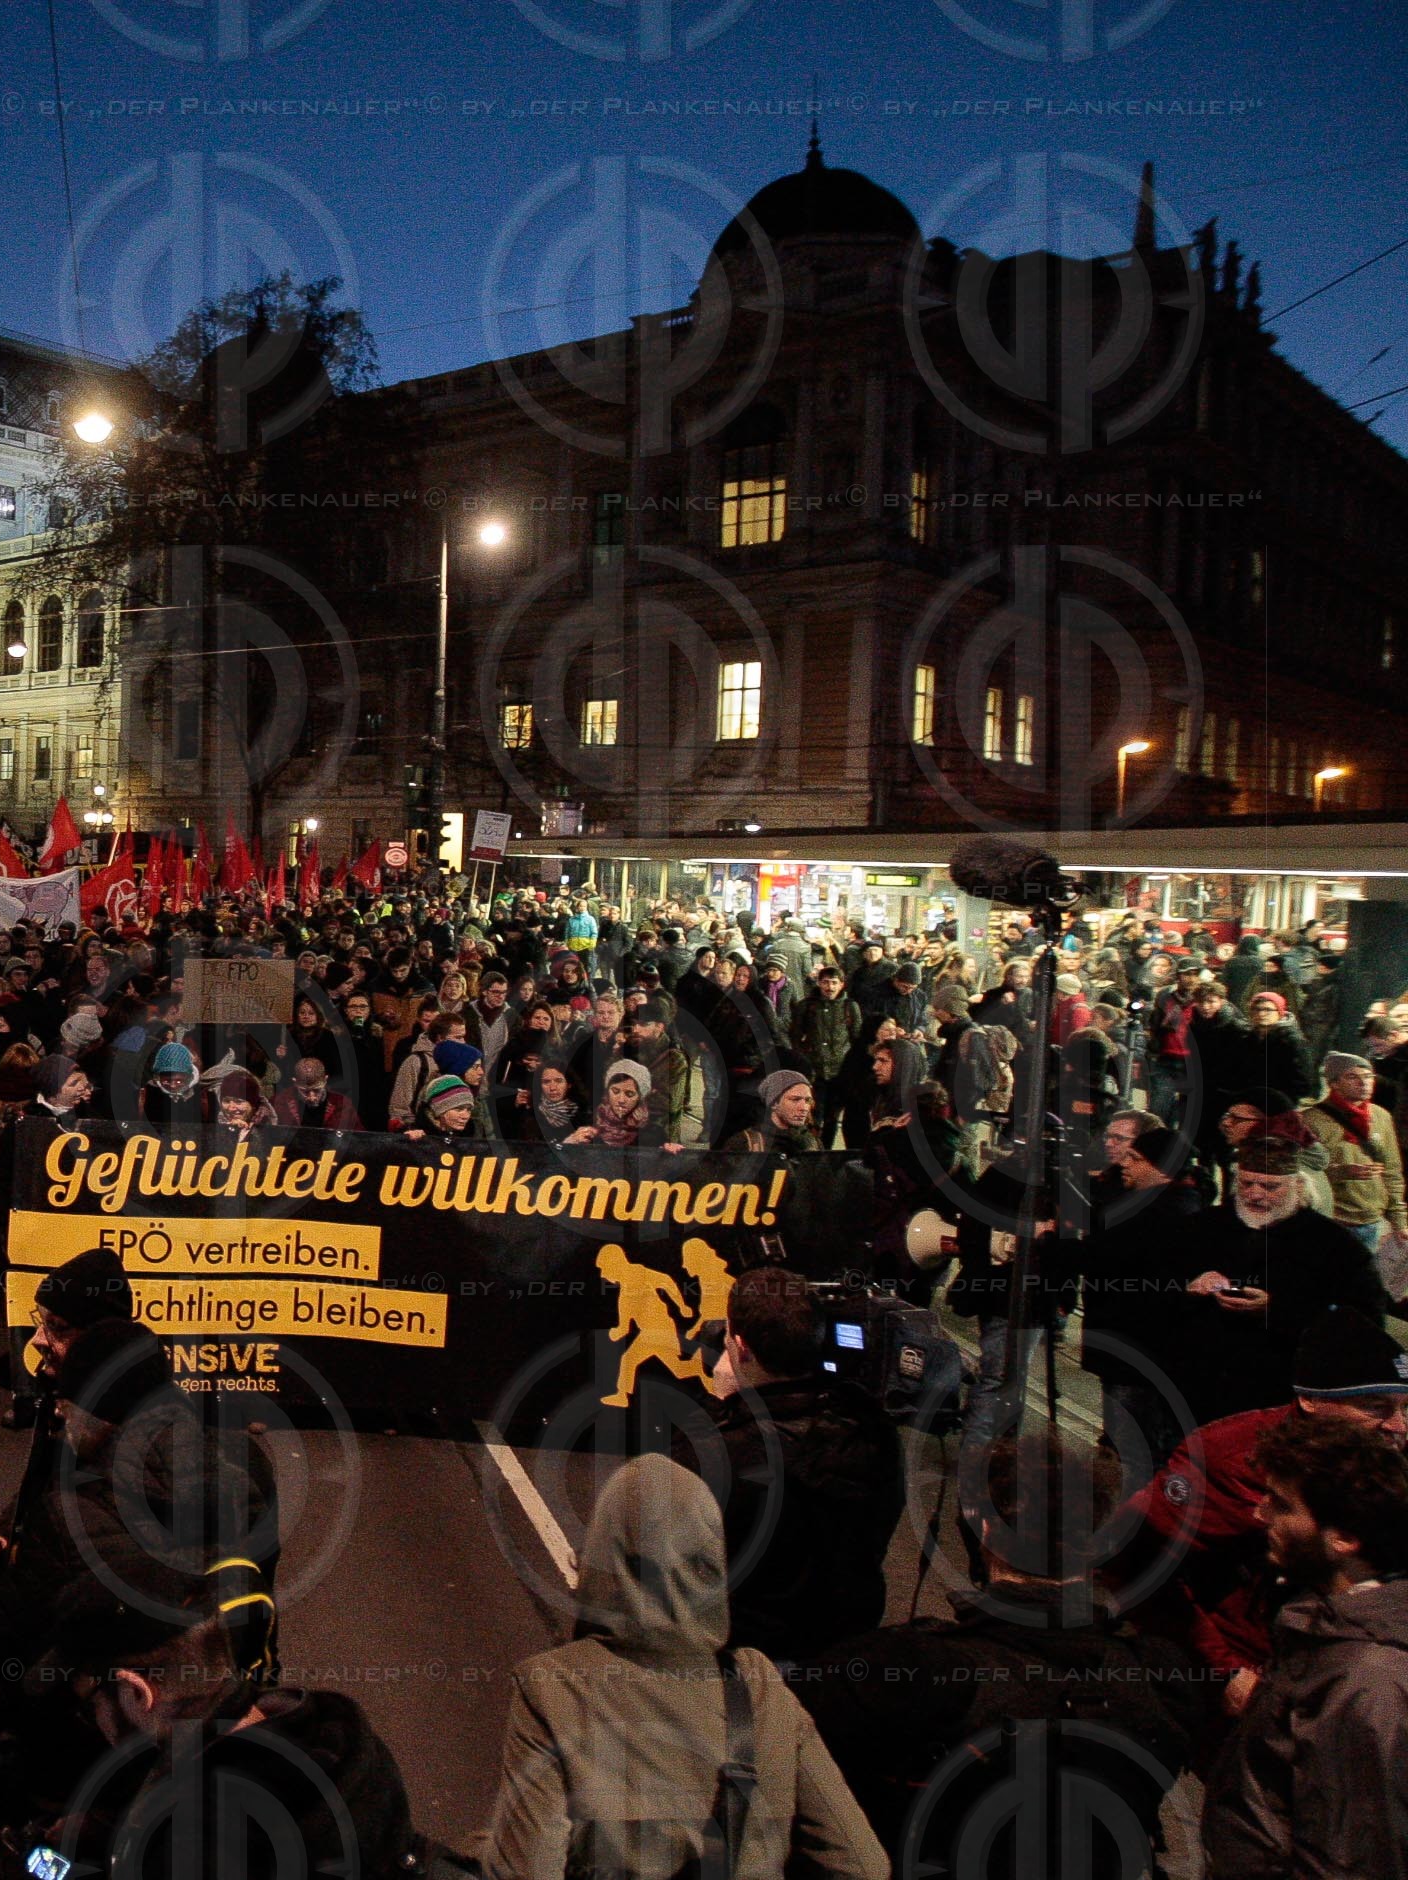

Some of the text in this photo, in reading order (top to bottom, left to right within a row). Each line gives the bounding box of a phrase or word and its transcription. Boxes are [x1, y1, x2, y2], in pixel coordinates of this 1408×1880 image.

[45, 1133, 787, 1226] Geflüchtete willkommen!
[186, 1231, 371, 1271] vertreiben.
[292, 1287, 437, 1335] bleiben.
[217, 1376, 280, 1392] rechts.
